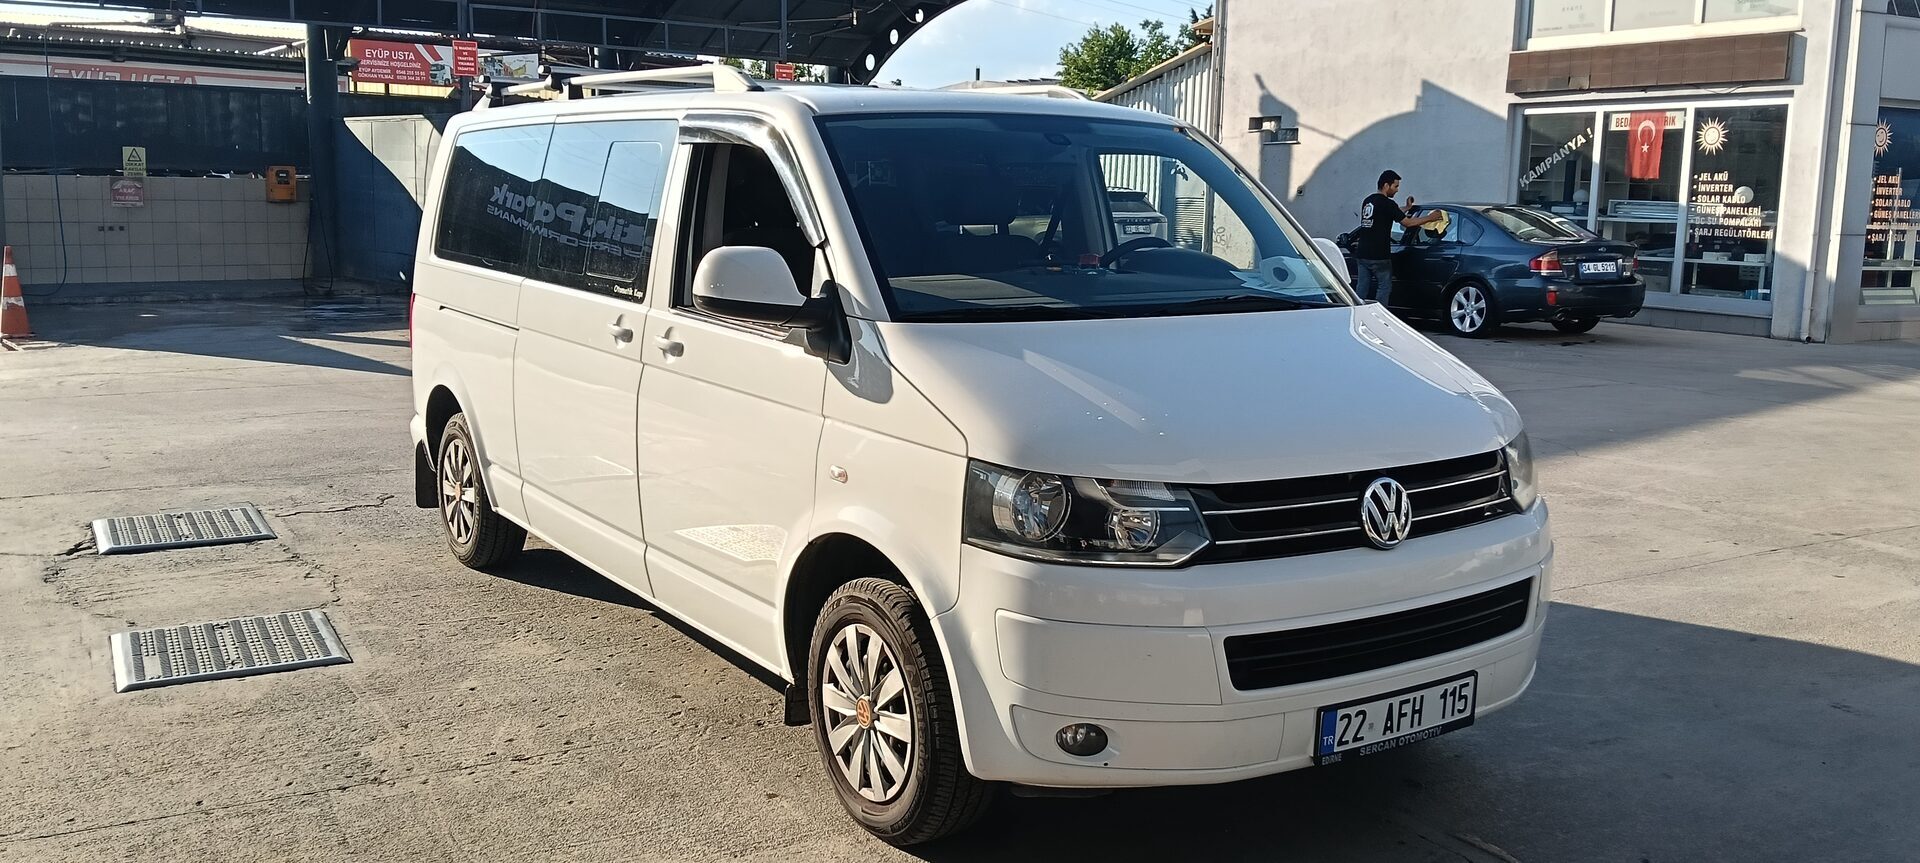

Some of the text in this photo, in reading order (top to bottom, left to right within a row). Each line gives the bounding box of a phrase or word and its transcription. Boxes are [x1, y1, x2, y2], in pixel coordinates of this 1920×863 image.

[365, 48, 415, 60] EYÜP USTA
[1519, 134, 1587, 188] KAMPANYA
[1699, 171, 1729, 181] JEL AKÜ
[1877, 175, 1887, 183] JEL
[1698, 182, 1734, 192] İNVERTER
[1697, 194, 1746, 204] SOLAR KABLO
[1875, 198, 1893, 207] SOLAR
[1696, 205, 1762, 217] GÜNEŞ PANELLERİ
[1708, 217, 1717, 225] SU
[1719, 217, 1762, 227] POMPALARI
[1694, 227, 1774, 239] ŞARJ REGÜLATÖRLERİ
[1323, 681, 1470, 747] TR 22 AFH 115
[1359, 737, 1396, 756] SERCAN
